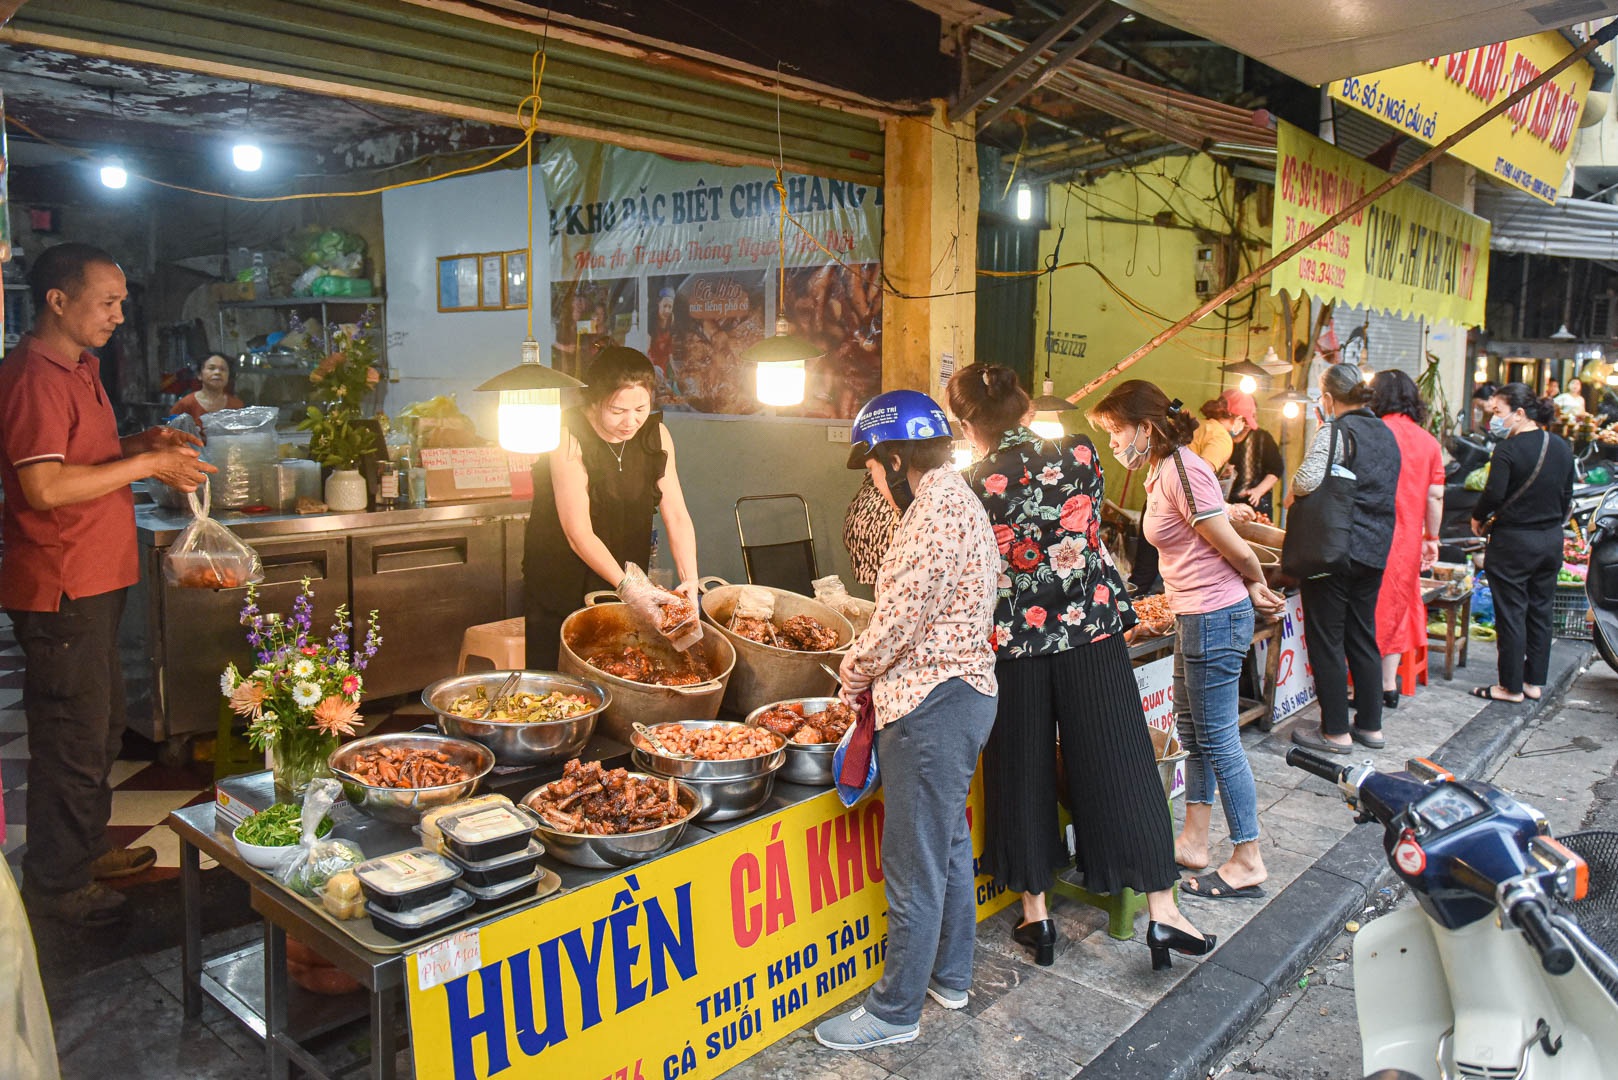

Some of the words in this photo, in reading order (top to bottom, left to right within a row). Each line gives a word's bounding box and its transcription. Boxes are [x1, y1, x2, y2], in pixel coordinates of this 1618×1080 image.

[1362, 80, 1380, 109] SỐ
[1377, 93, 1385, 113] 5
[564, 201, 617, 235] KHO
[672, 178, 724, 232] BIỆT
[1142, 688, 1165, 712] QUAY
[443, 874, 698, 1080] HUYỀN
[730, 820, 796, 948] CÁ
[805, 799, 885, 914] KHO
[696, 973, 757, 1025] THỊT
[767, 943, 819, 990] KHO
[826, 914, 870, 956] TÀU
[663, 1040, 697, 1080] CÁ
[706, 1004, 762, 1060] SUỐI
[772, 982, 808, 1023] HAI
[816, 955, 857, 998] RIM
[863, 933, 888, 970] TIÊ
